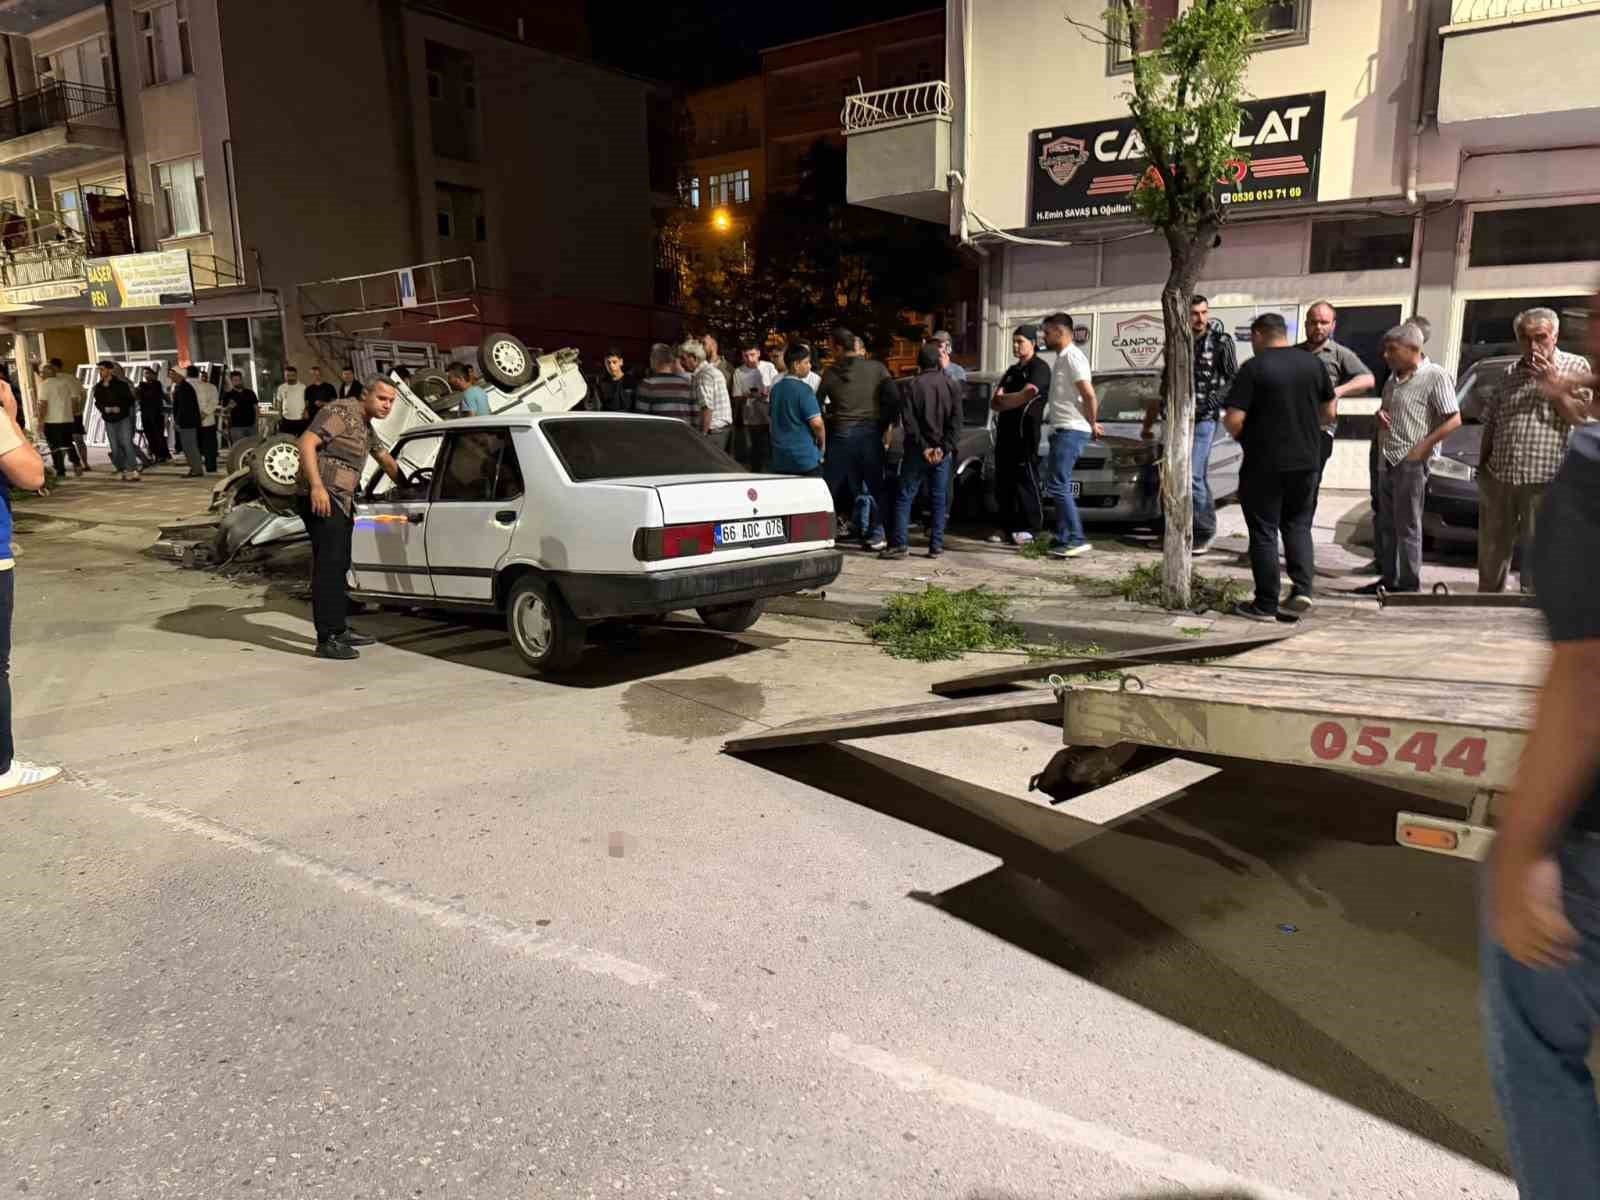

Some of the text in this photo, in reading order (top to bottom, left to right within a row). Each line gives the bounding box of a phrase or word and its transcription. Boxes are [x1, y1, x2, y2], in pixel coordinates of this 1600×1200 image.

[1276, 188, 1287, 199] 71
[1036, 210, 1064, 222] H.Emin
[1064, 206, 1090, 219] SAVAŞ
[1100, 204, 1132, 217] Oğulları
[1111, 336, 1163, 347] CANPOL
[1129, 346, 1157, 355] AUTO
[722, 525, 736, 541] 66
[742, 522, 760, 540] ADC
[765, 519, 783, 536] 076
[1310, 721, 1487, 777] 0544
